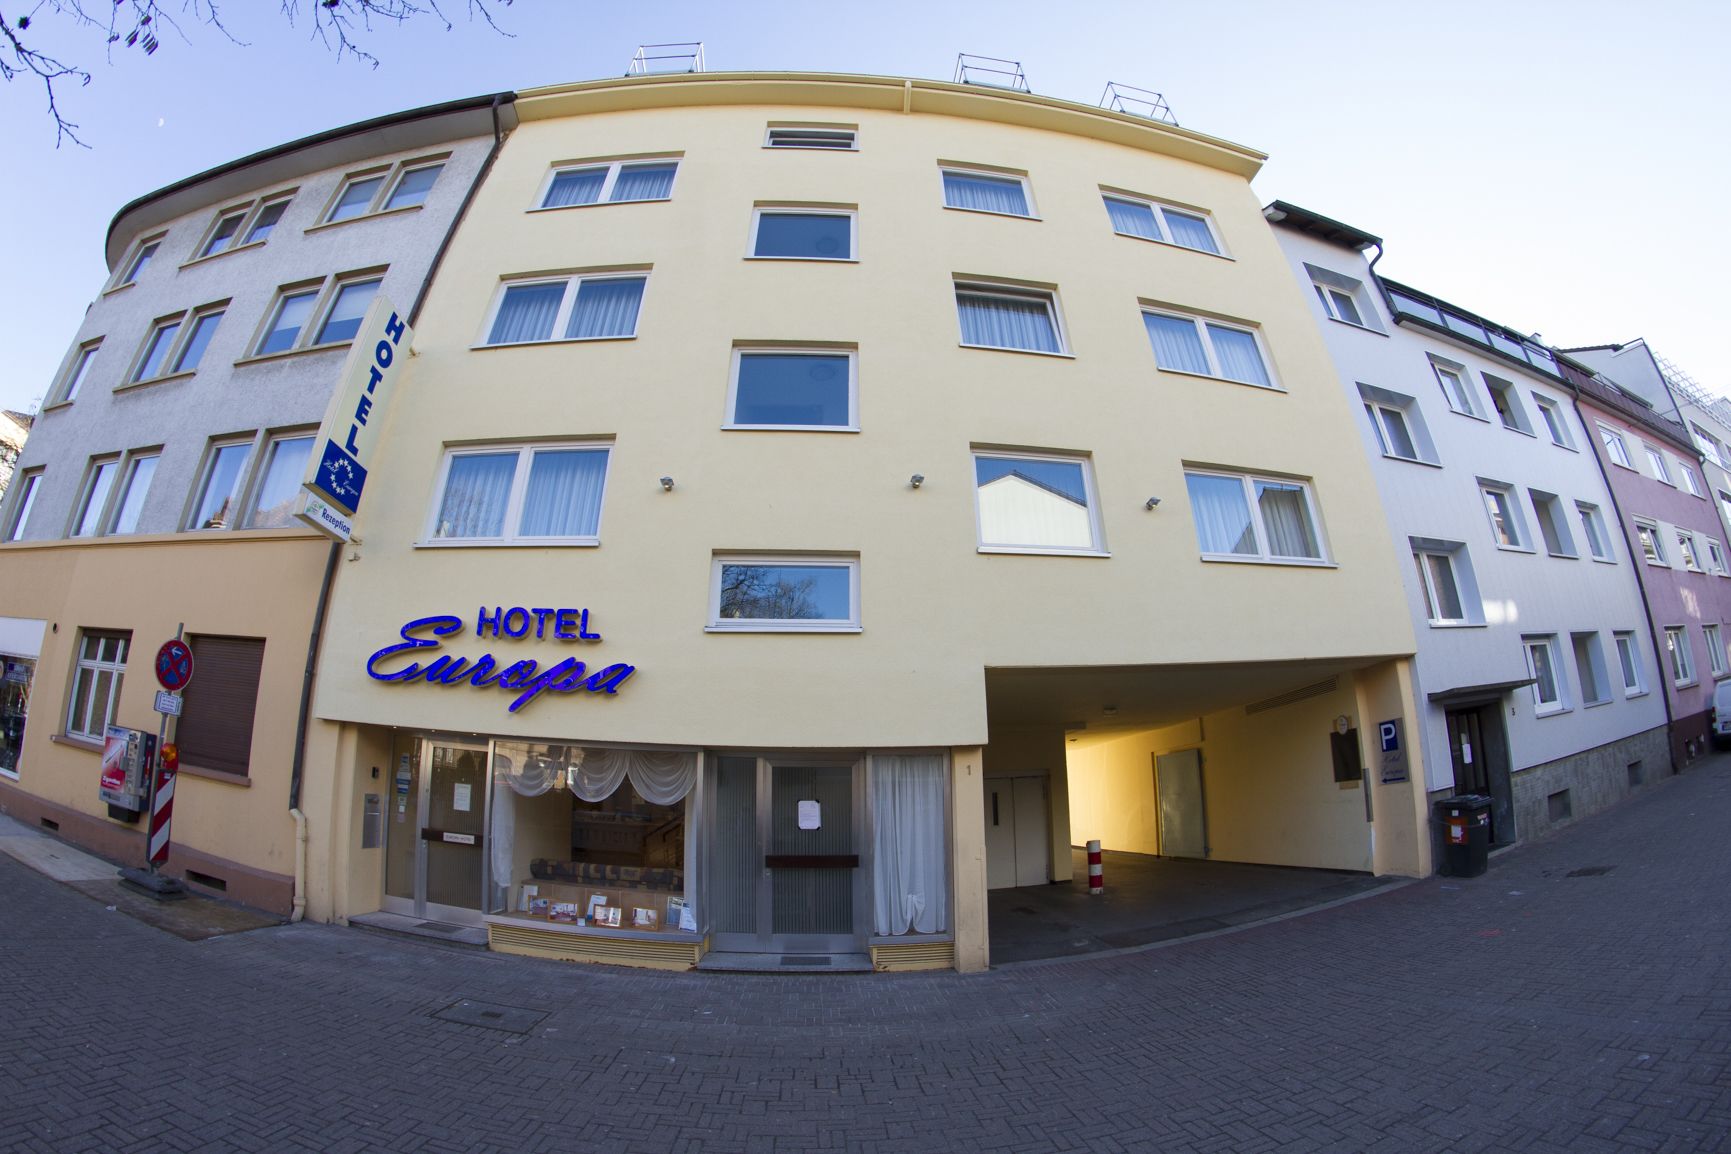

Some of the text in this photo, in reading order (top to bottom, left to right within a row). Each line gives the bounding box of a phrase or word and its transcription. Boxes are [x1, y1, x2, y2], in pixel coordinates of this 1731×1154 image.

[345, 311, 406, 458] HOTEL
[322, 508, 351, 535] Rezeption
[476, 606, 602, 640] HOTEL
[366, 615, 637, 713] Europa
[1380, 723, 1396, 750] P
[966, 764, 972, 776] 1
